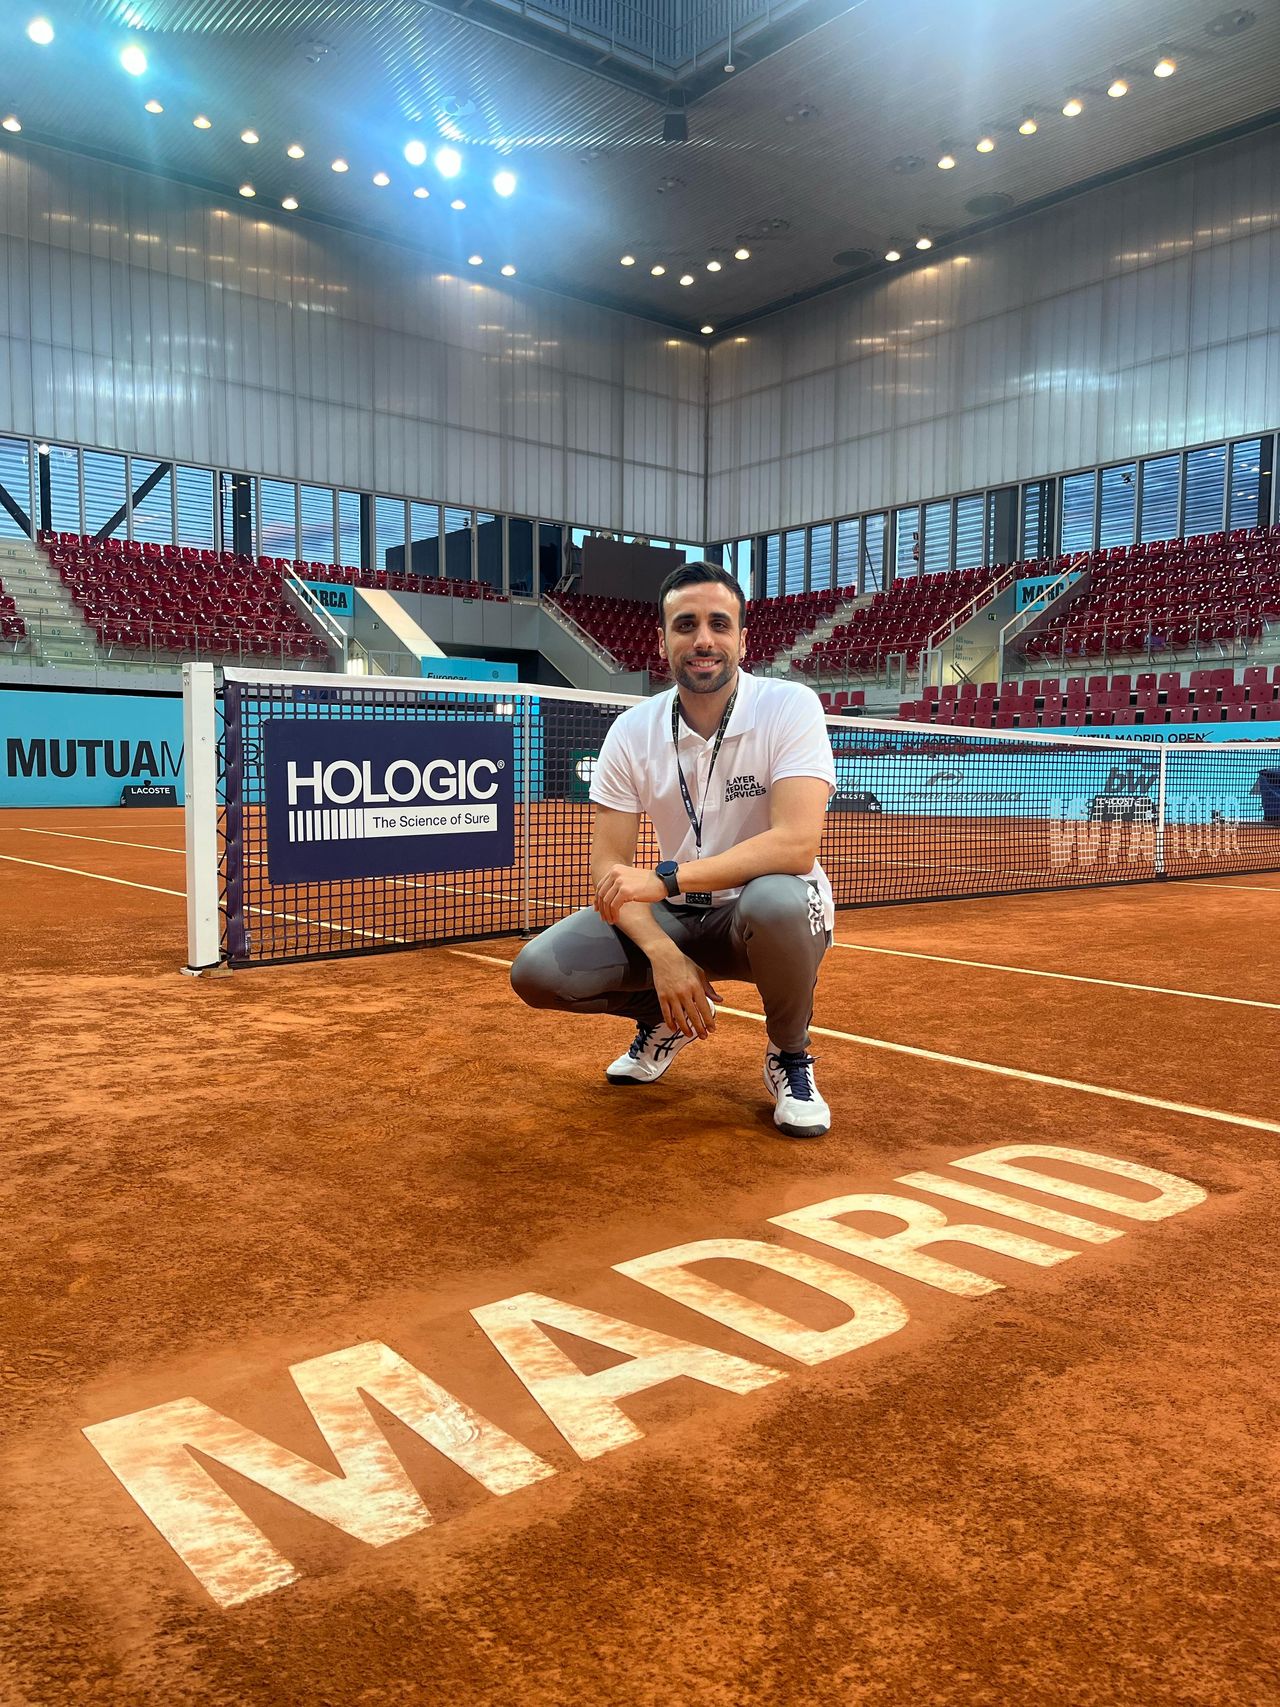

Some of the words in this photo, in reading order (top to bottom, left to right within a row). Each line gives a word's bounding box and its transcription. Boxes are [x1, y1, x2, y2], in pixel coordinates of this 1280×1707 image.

[1022, 582, 1073, 604] MARC
[1167, 733, 1205, 743] OPEN
[130, 787, 171, 795] LACOSTE
[725, 787, 767, 802] SERVICES
[373, 816, 396, 828] The
[399, 813, 447, 828] Science
[450, 813, 462, 826] of
[464, 812, 490, 824] Sure
[81, 1144, 1208, 1608] MADRID
